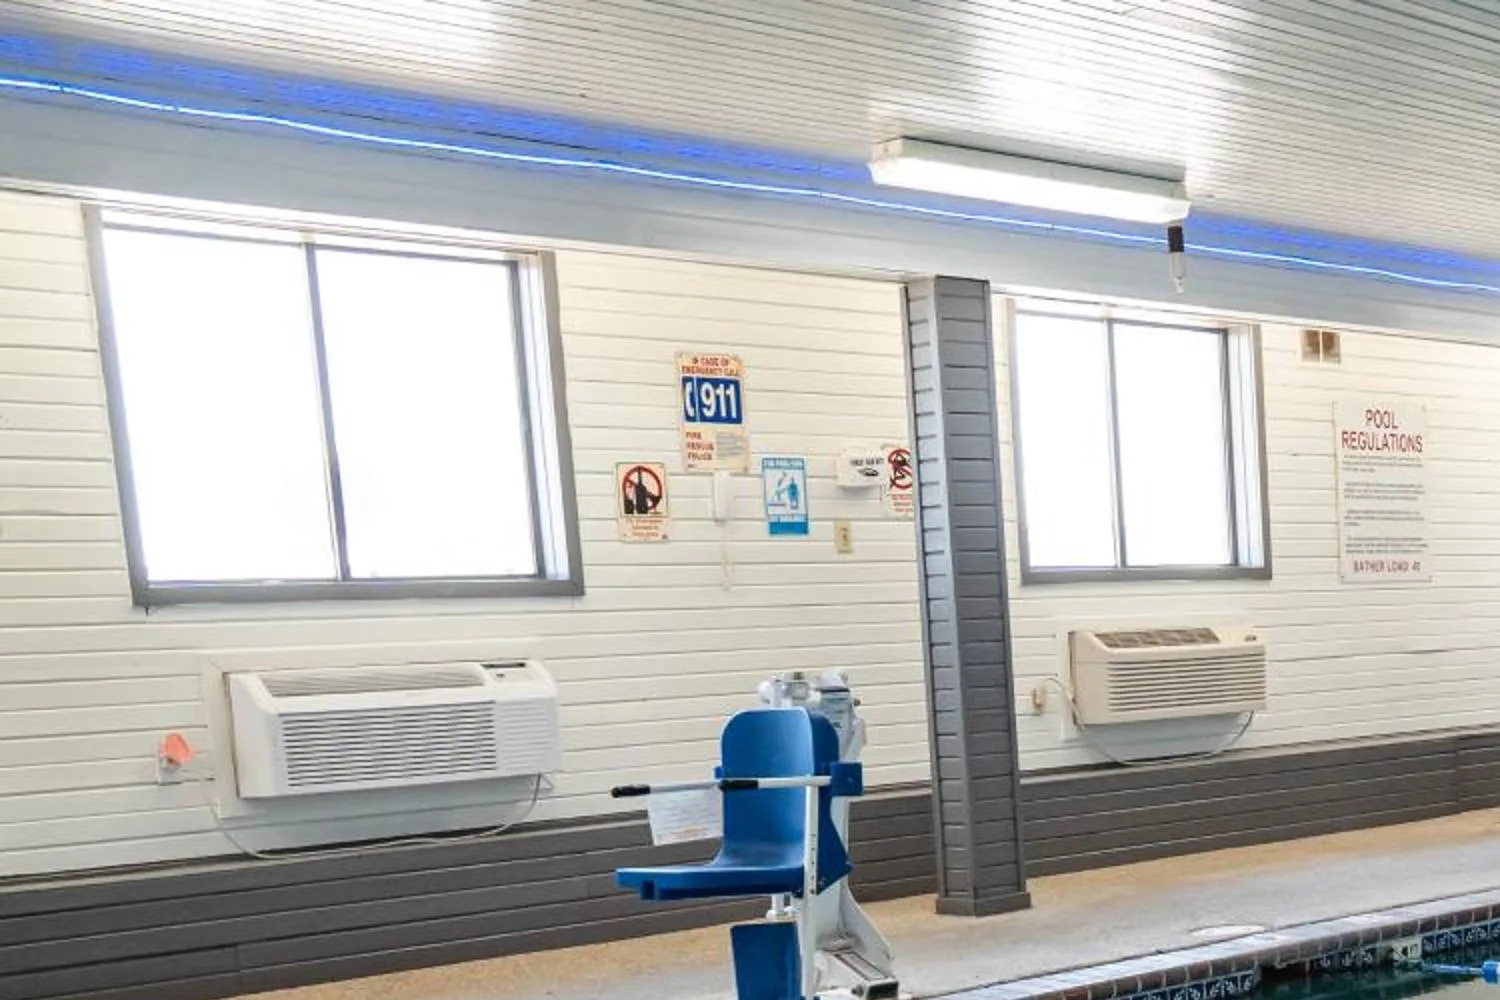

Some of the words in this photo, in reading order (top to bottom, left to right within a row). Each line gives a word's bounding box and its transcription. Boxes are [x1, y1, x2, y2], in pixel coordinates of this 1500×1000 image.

[701, 382, 738, 418] 911
[1365, 409, 1399, 429] POOL
[1342, 431, 1423, 453] REGULATIONS
